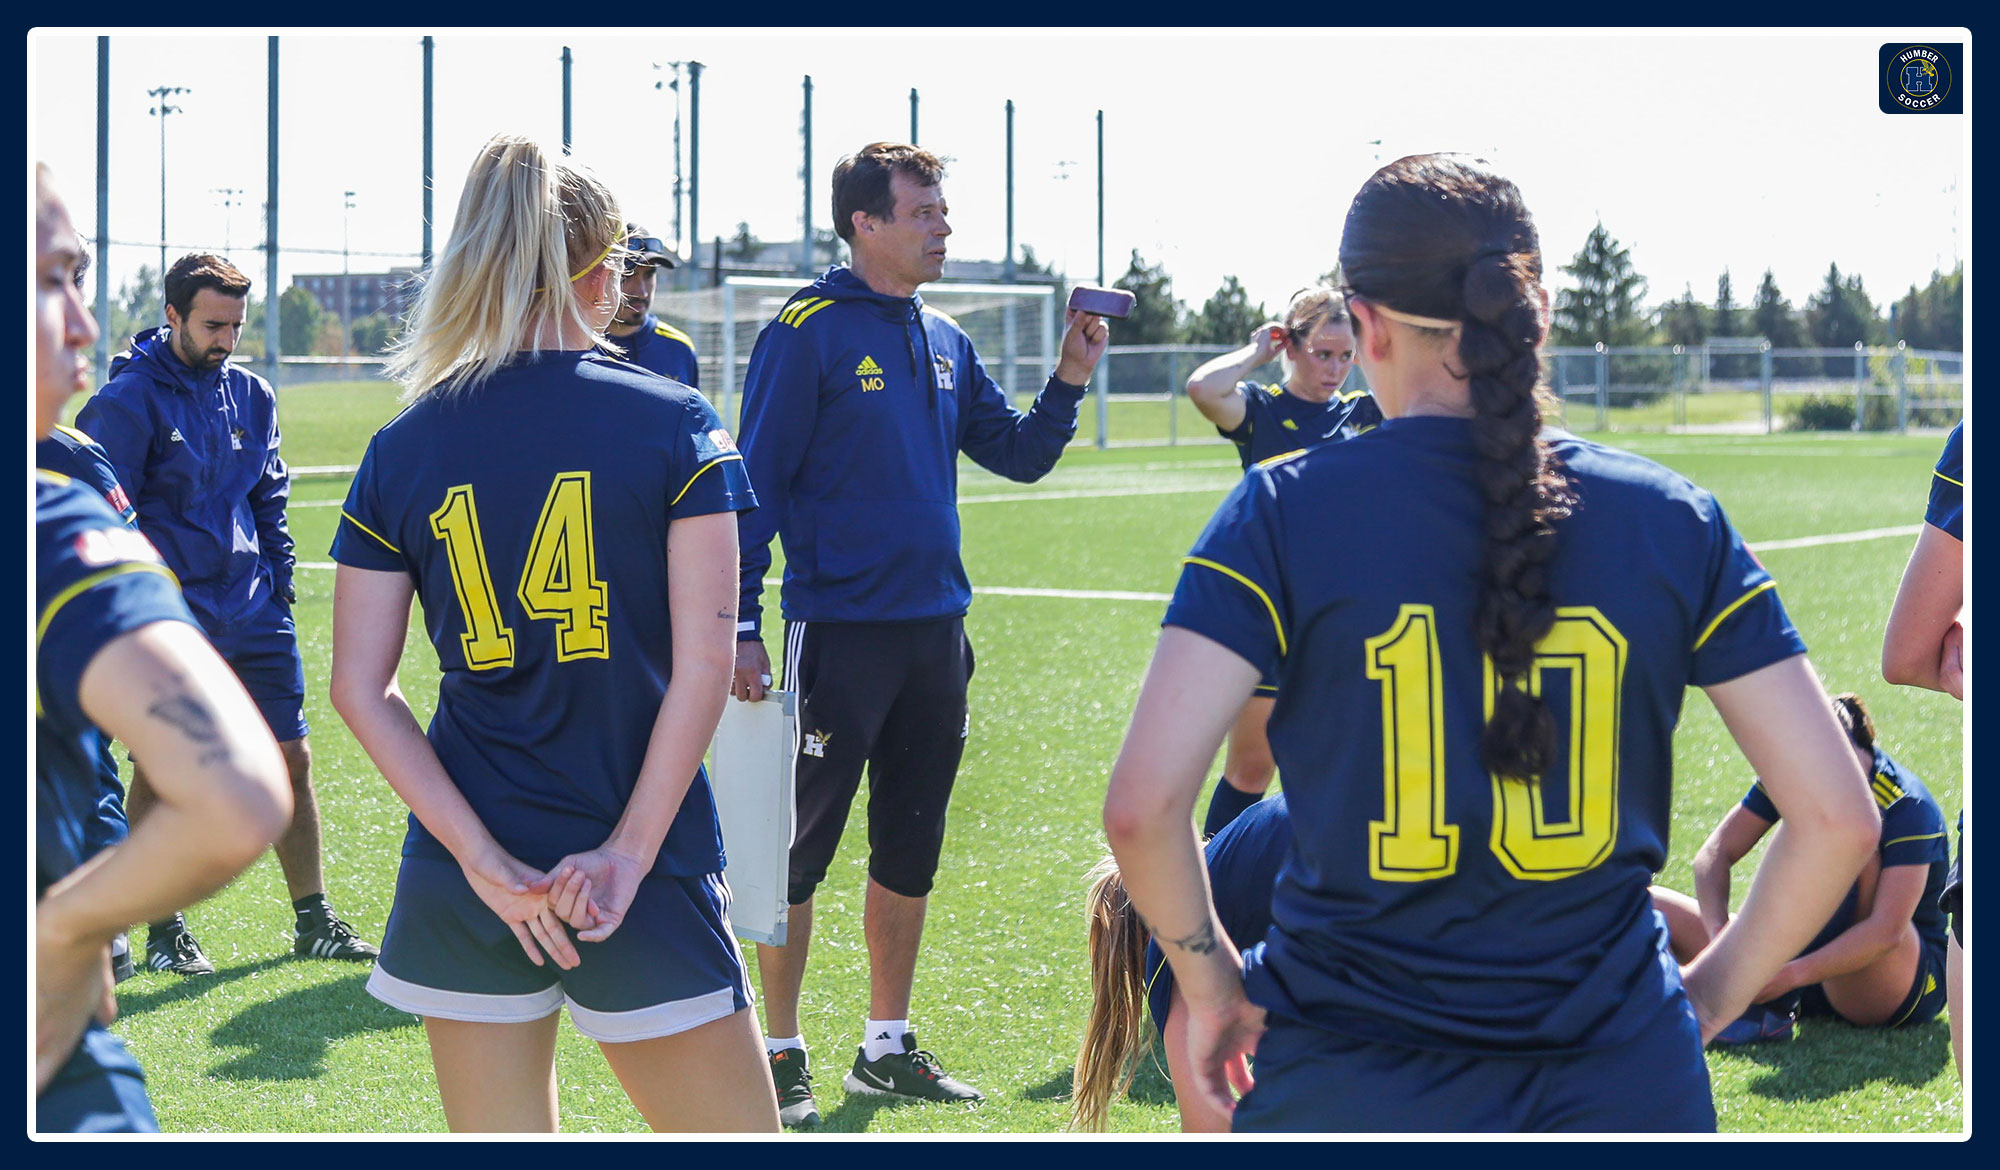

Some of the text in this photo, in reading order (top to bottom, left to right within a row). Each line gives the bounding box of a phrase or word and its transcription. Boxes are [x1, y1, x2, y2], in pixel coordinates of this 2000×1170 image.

[861, 377, 885, 393] MO
[429, 470, 610, 672] 14
[1364, 603, 1629, 883] 10
